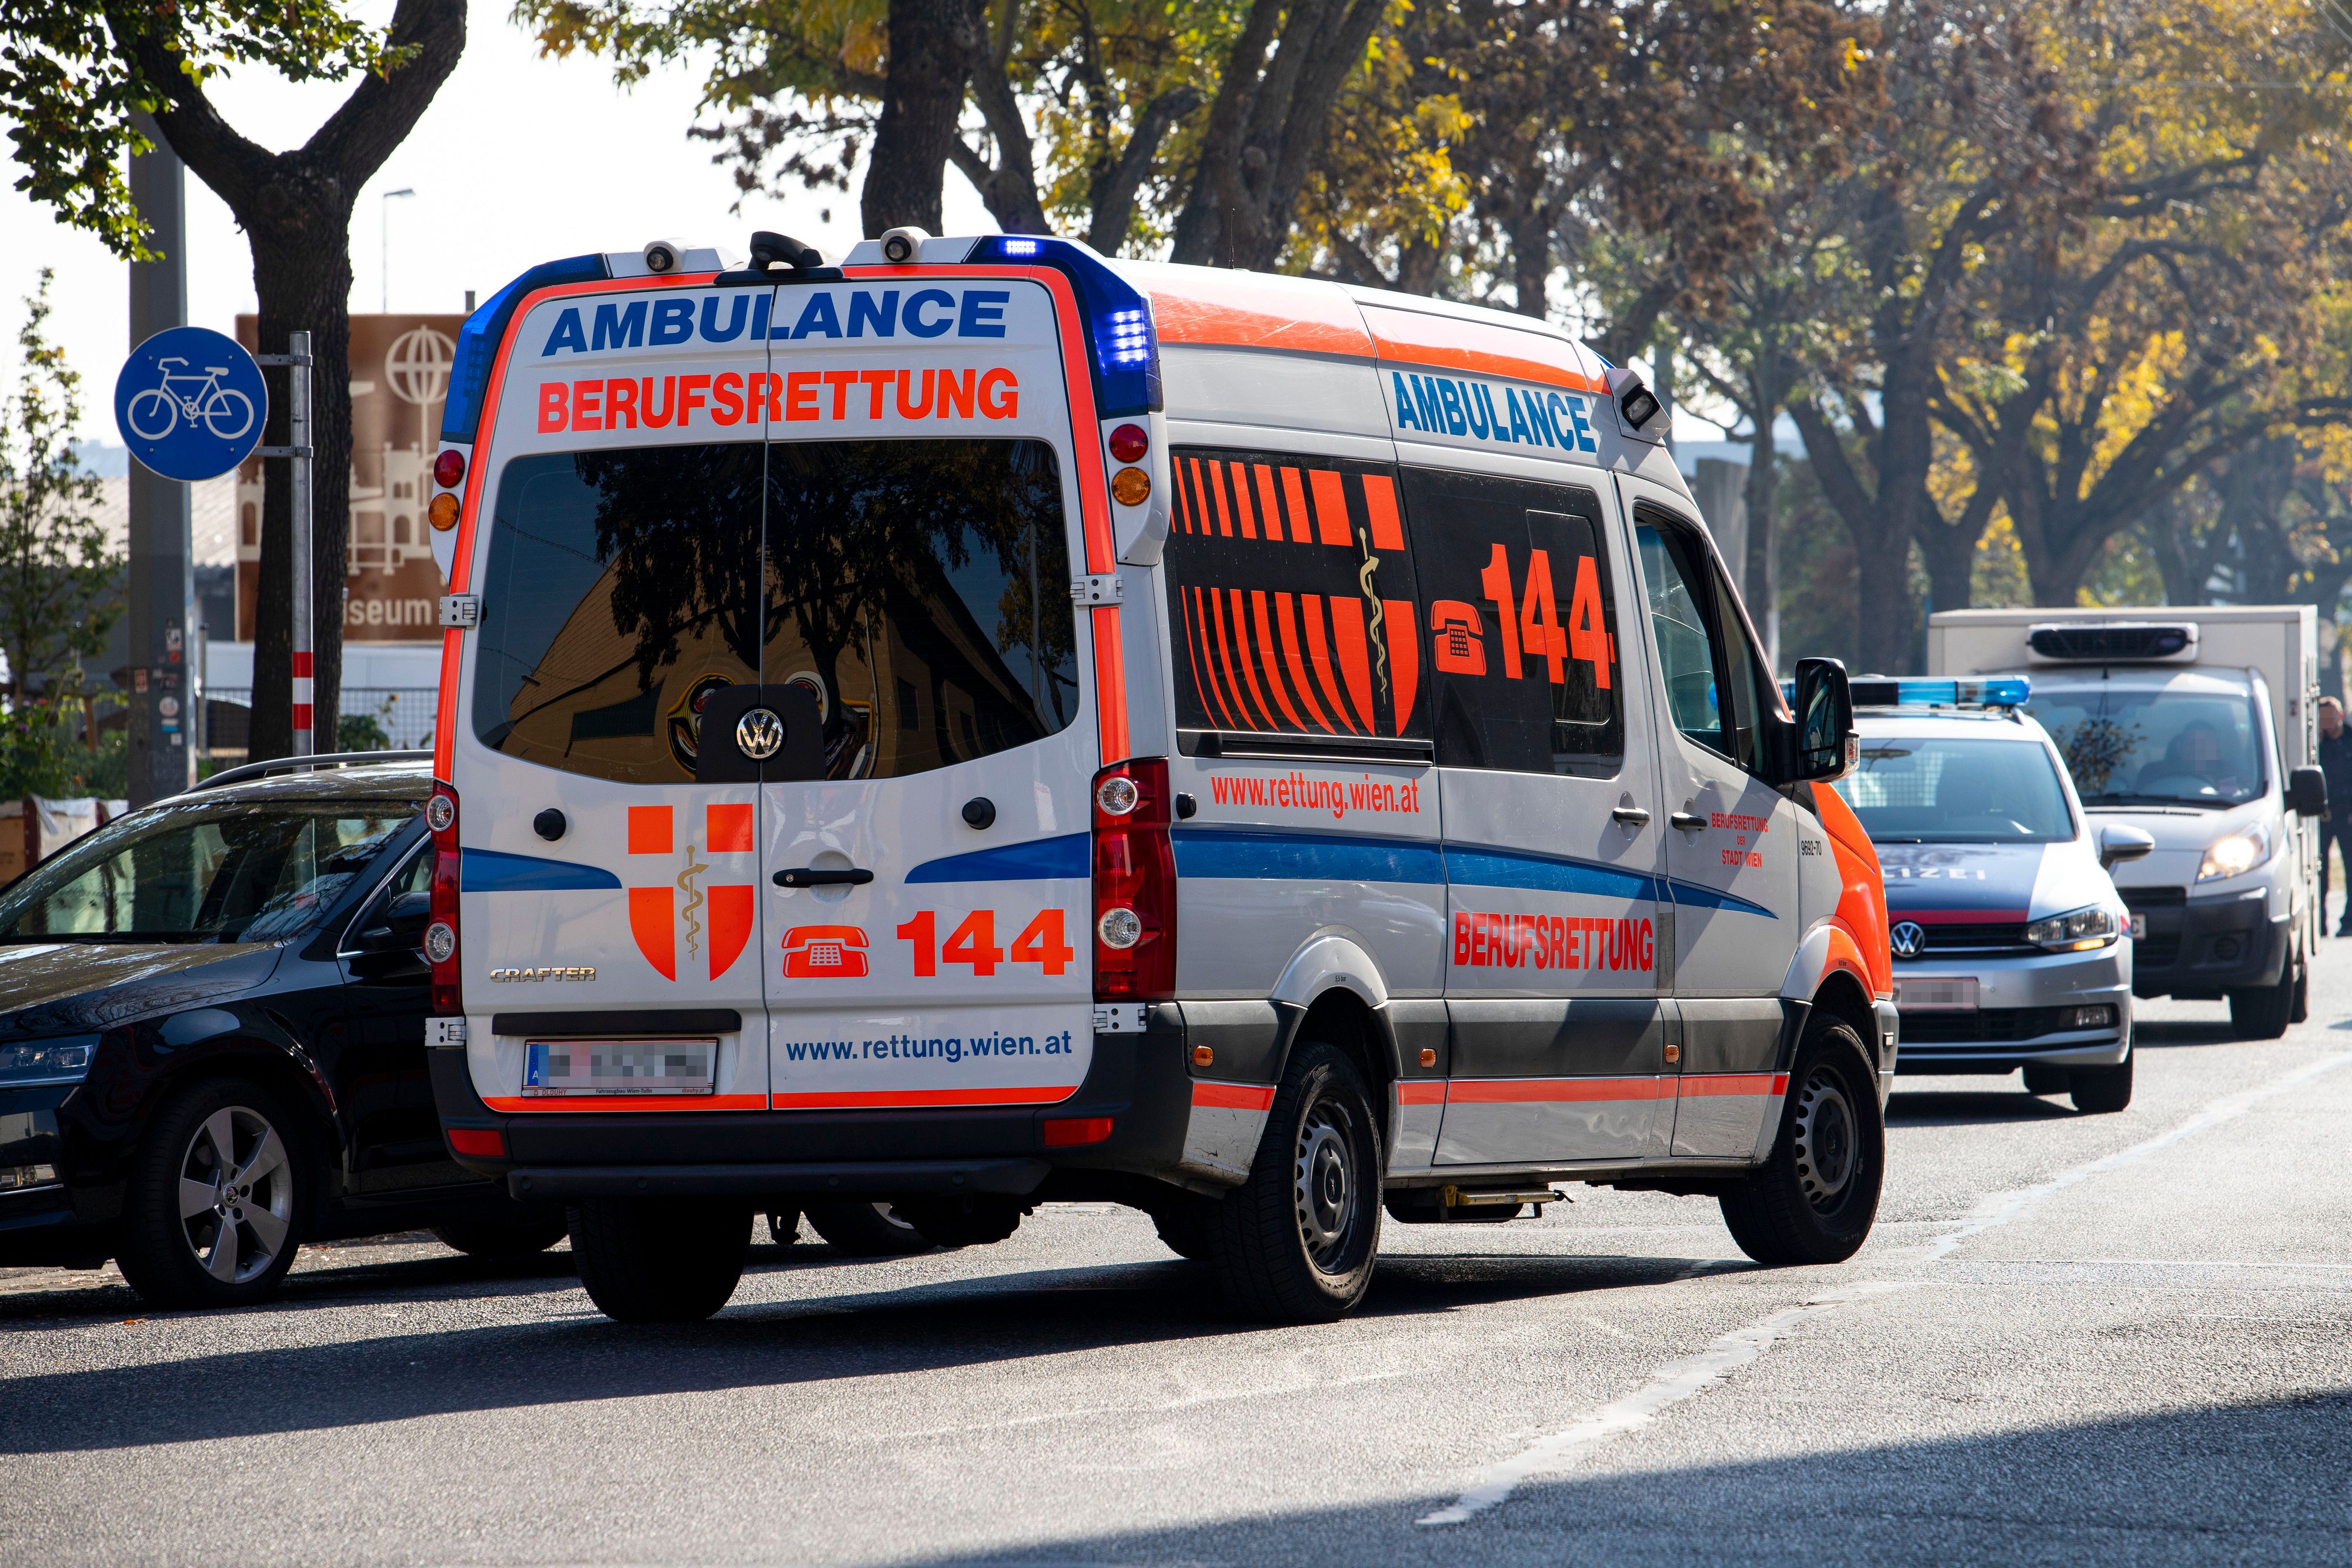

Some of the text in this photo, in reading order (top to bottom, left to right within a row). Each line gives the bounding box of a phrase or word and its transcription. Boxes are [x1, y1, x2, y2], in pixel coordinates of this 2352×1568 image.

[541, 289, 1010, 357] AMBULANCE
[537, 367, 1018, 434] BERUFSRETTUNG
[1392, 371, 1596, 453] AMBULANCE
[342, 599, 432, 626] seum
[1481, 543, 1616, 690] 144
[1211, 771, 1420, 819] www.rettung.wien.at
[1711, 813, 1769, 833] BERUFSRETTUNG
[1736, 835, 1746, 845] DER
[1722, 850, 1762, 867] STADT WIEN
[1801, 840, 1822, 855] 9692-70
[1881, 867, 1986, 881] LIZEI
[896, 908, 1074, 978] 144
[1454, 911, 1653, 972] BERUFSRETTUNG
[490, 967, 596, 983] CRAFTER
[785, 1029, 1073, 1064] www.rettung.wien.at
